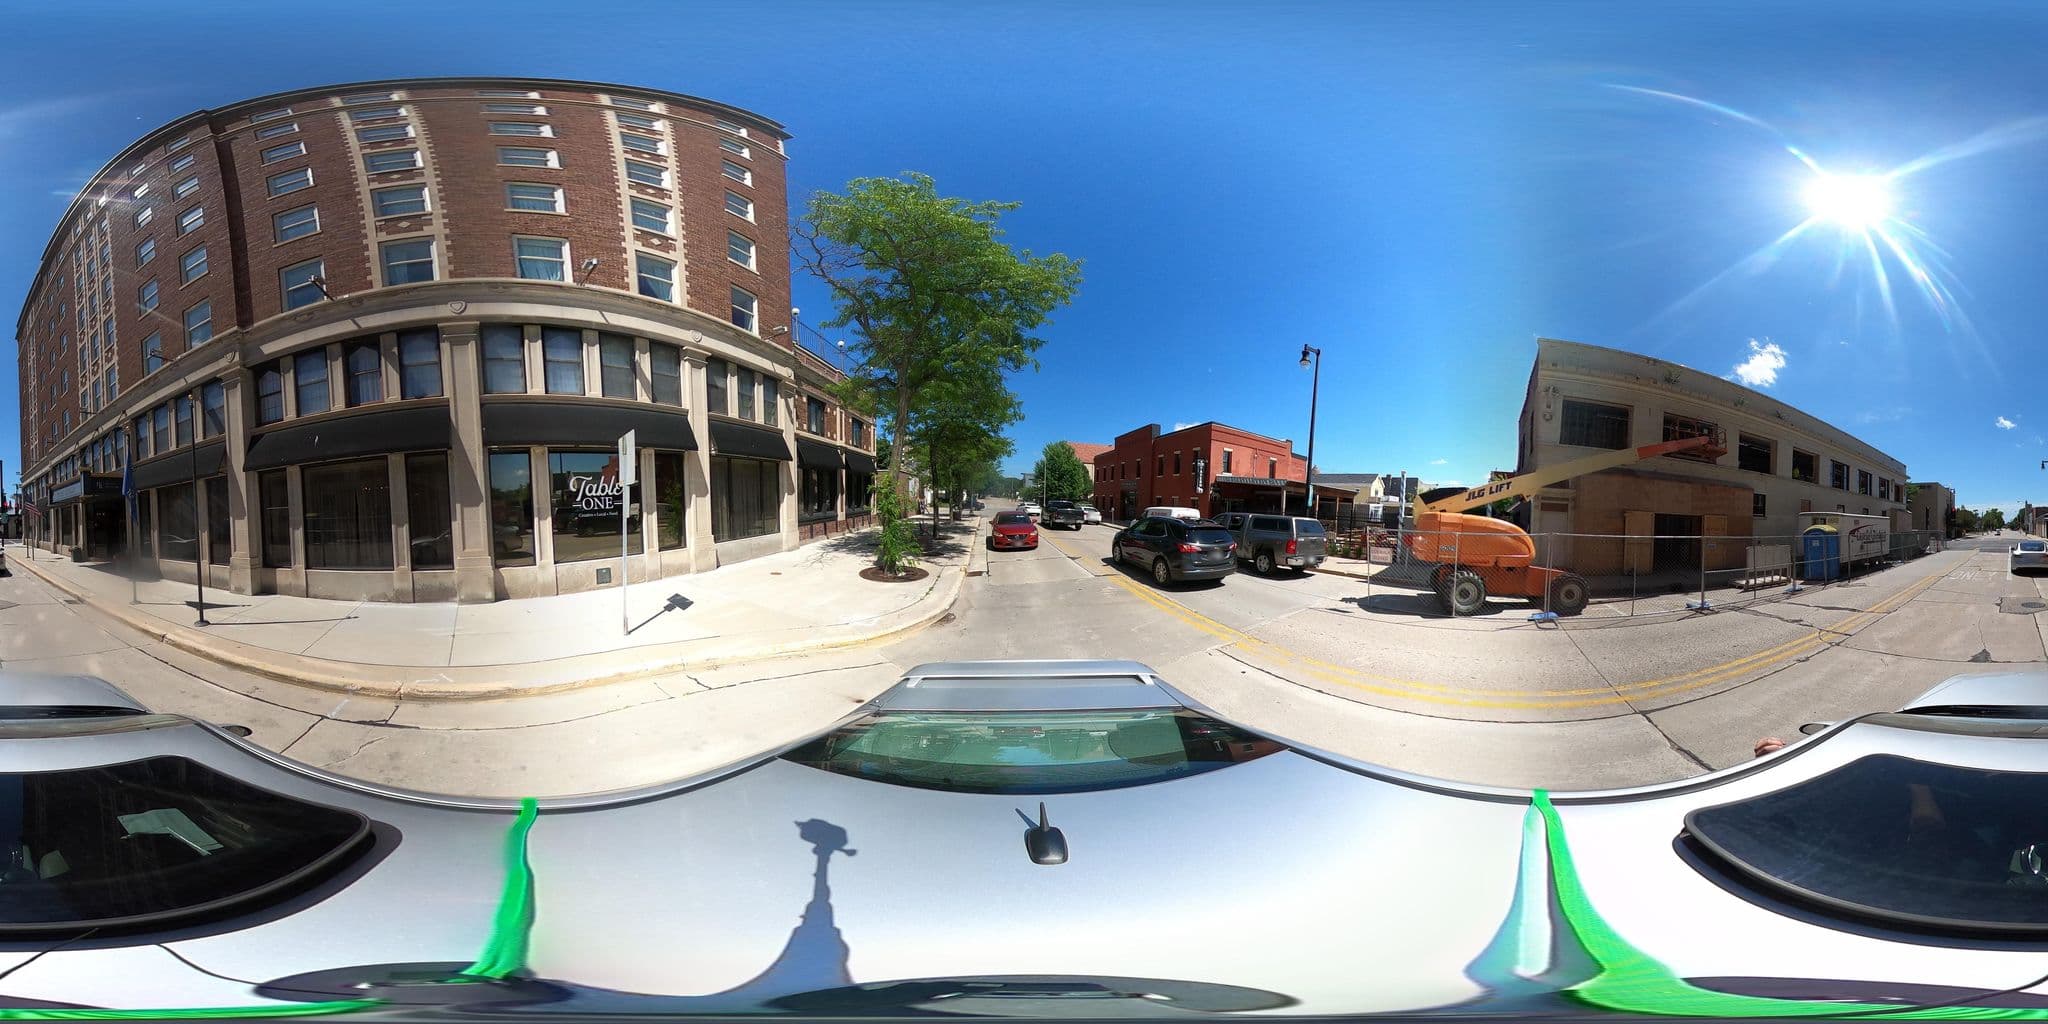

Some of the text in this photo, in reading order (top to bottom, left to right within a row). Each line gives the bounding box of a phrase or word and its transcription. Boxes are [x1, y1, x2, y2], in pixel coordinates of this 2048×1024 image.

[570, 475, 624, 501] Table
[1465, 481, 1512, 501] JLG LIFT
[582, 497, 614, 510] ONE
